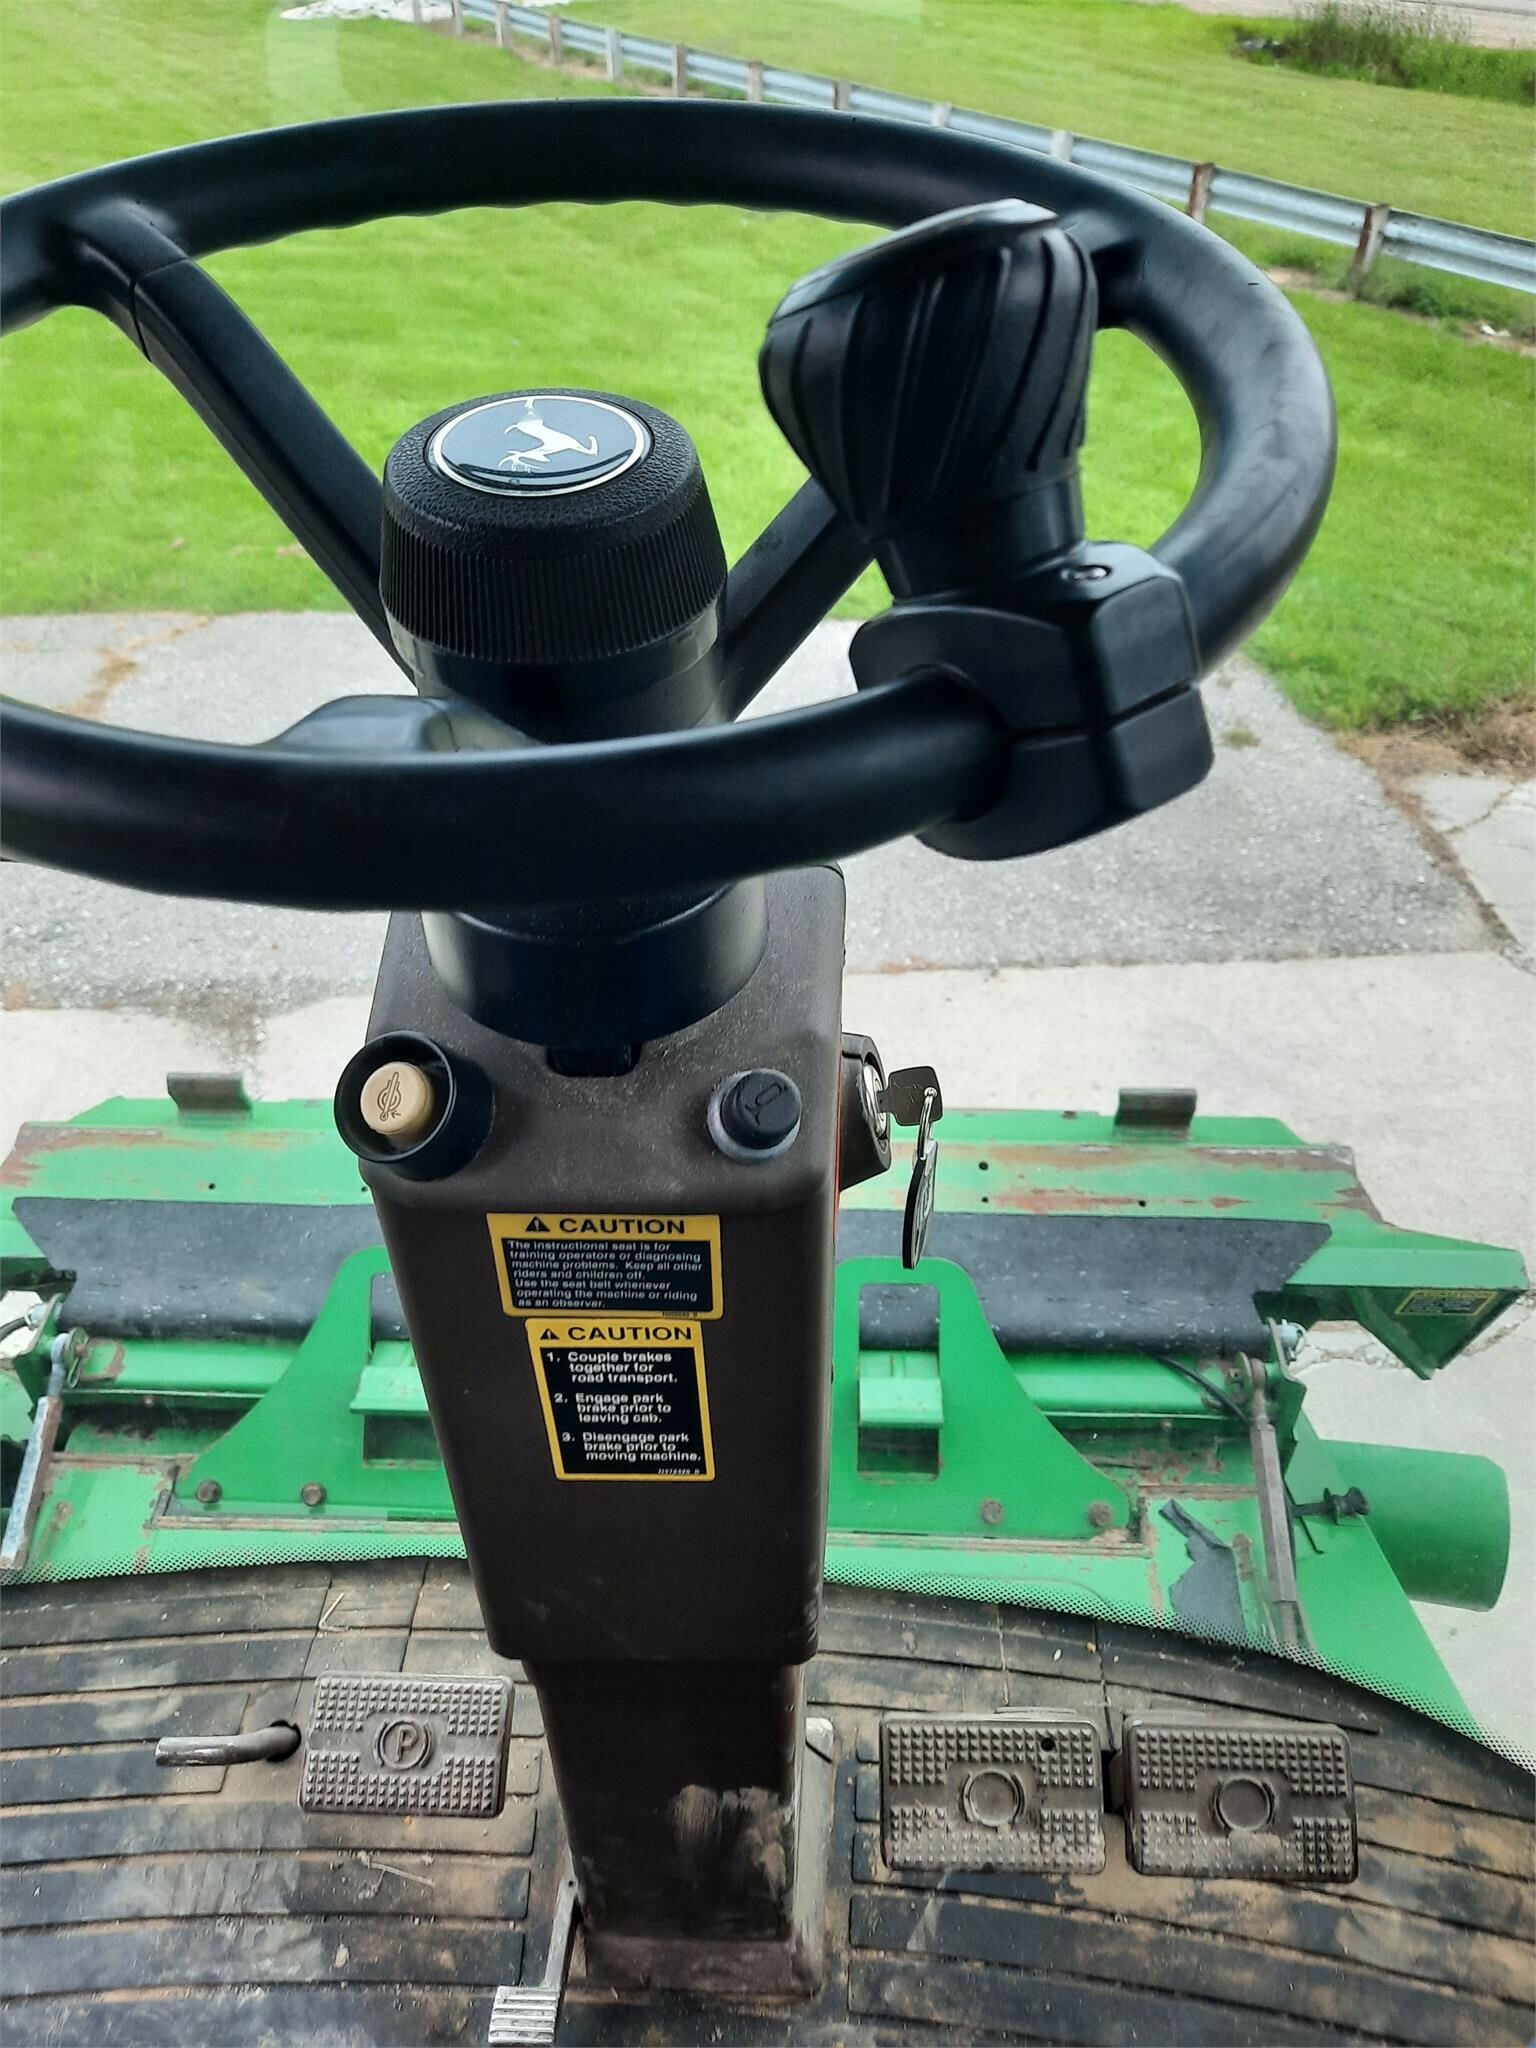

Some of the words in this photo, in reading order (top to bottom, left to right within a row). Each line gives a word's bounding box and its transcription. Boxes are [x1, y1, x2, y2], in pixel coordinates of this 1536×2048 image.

[559, 1219, 685, 1234] CAUTION
[508, 1240, 530, 1250] The
[534, 1241, 608, 1250] instructional
[612, 1242, 636, 1250] seat
[641, 1242, 650, 1251] is
[654, 1242, 670, 1251] for
[510, 1251, 555, 1260] training
[559, 1252, 615, 1260] operators
[635, 1252, 701, 1262] diagnosing
[512, 1260, 560, 1269] machine
[563, 1261, 618, 1270] problems.
[625, 1262, 653, 1271] Keep
[657, 1262, 670, 1270] all
[673, 1262, 703, 1271] other
[514, 1269, 547, 1278] riders
[551, 1270, 572, 1278] and
[576, 1270, 623, 1279] children
[627, 1271, 645, 1280] off.
[515, 1279, 537, 1288] Use
[541, 1280, 559, 1288] the
[562, 1280, 586, 1289] seat
[590, 1280, 611, 1289] belt
[615, 1280, 670, 1289] whenever
[517, 1289, 571, 1299] operating
[575, 1290, 593, 1298] the
[597, 1290, 644, 1299] machine
[664, 1291, 697, 1301] riding
[552, 1299, 605, 1308] observer.
[568, 1327, 692, 1340] CAUTION
[547, 1353, 560, 1362] 1.
[568, 1352, 619, 1364] Couple
[623, 1352, 672, 1362] brakes
[569, 1363, 629, 1373] together
[634, 1363, 653, 1372] for
[572, 1373, 604, 1382] road
[608, 1373, 678, 1384] transport.
[554, 1393, 568, 1403] 2.
[576, 1393, 628, 1405] Engage
[633, 1393, 663, 1405] park
[577, 1403, 616, 1413] brake
[621, 1403, 653, 1415] prior
[658, 1404, 671, 1413] to
[579, 1413, 629, 1424] leaving
[633, 1414, 662, 1423] cab.
[562, 1433, 575, 1442] 3.
[583, 1433, 655, 1444] Disengage
[659, 1433, 689, 1444] park
[584, 1442, 622, 1452] brake
[627, 1443, 658, 1454] prior
[662, 1443, 676, 1452] to
[586, 1452, 636, 1462] moving
[641, 1452, 701, 1461] machine.
[395, 1724, 418, 1763] P
